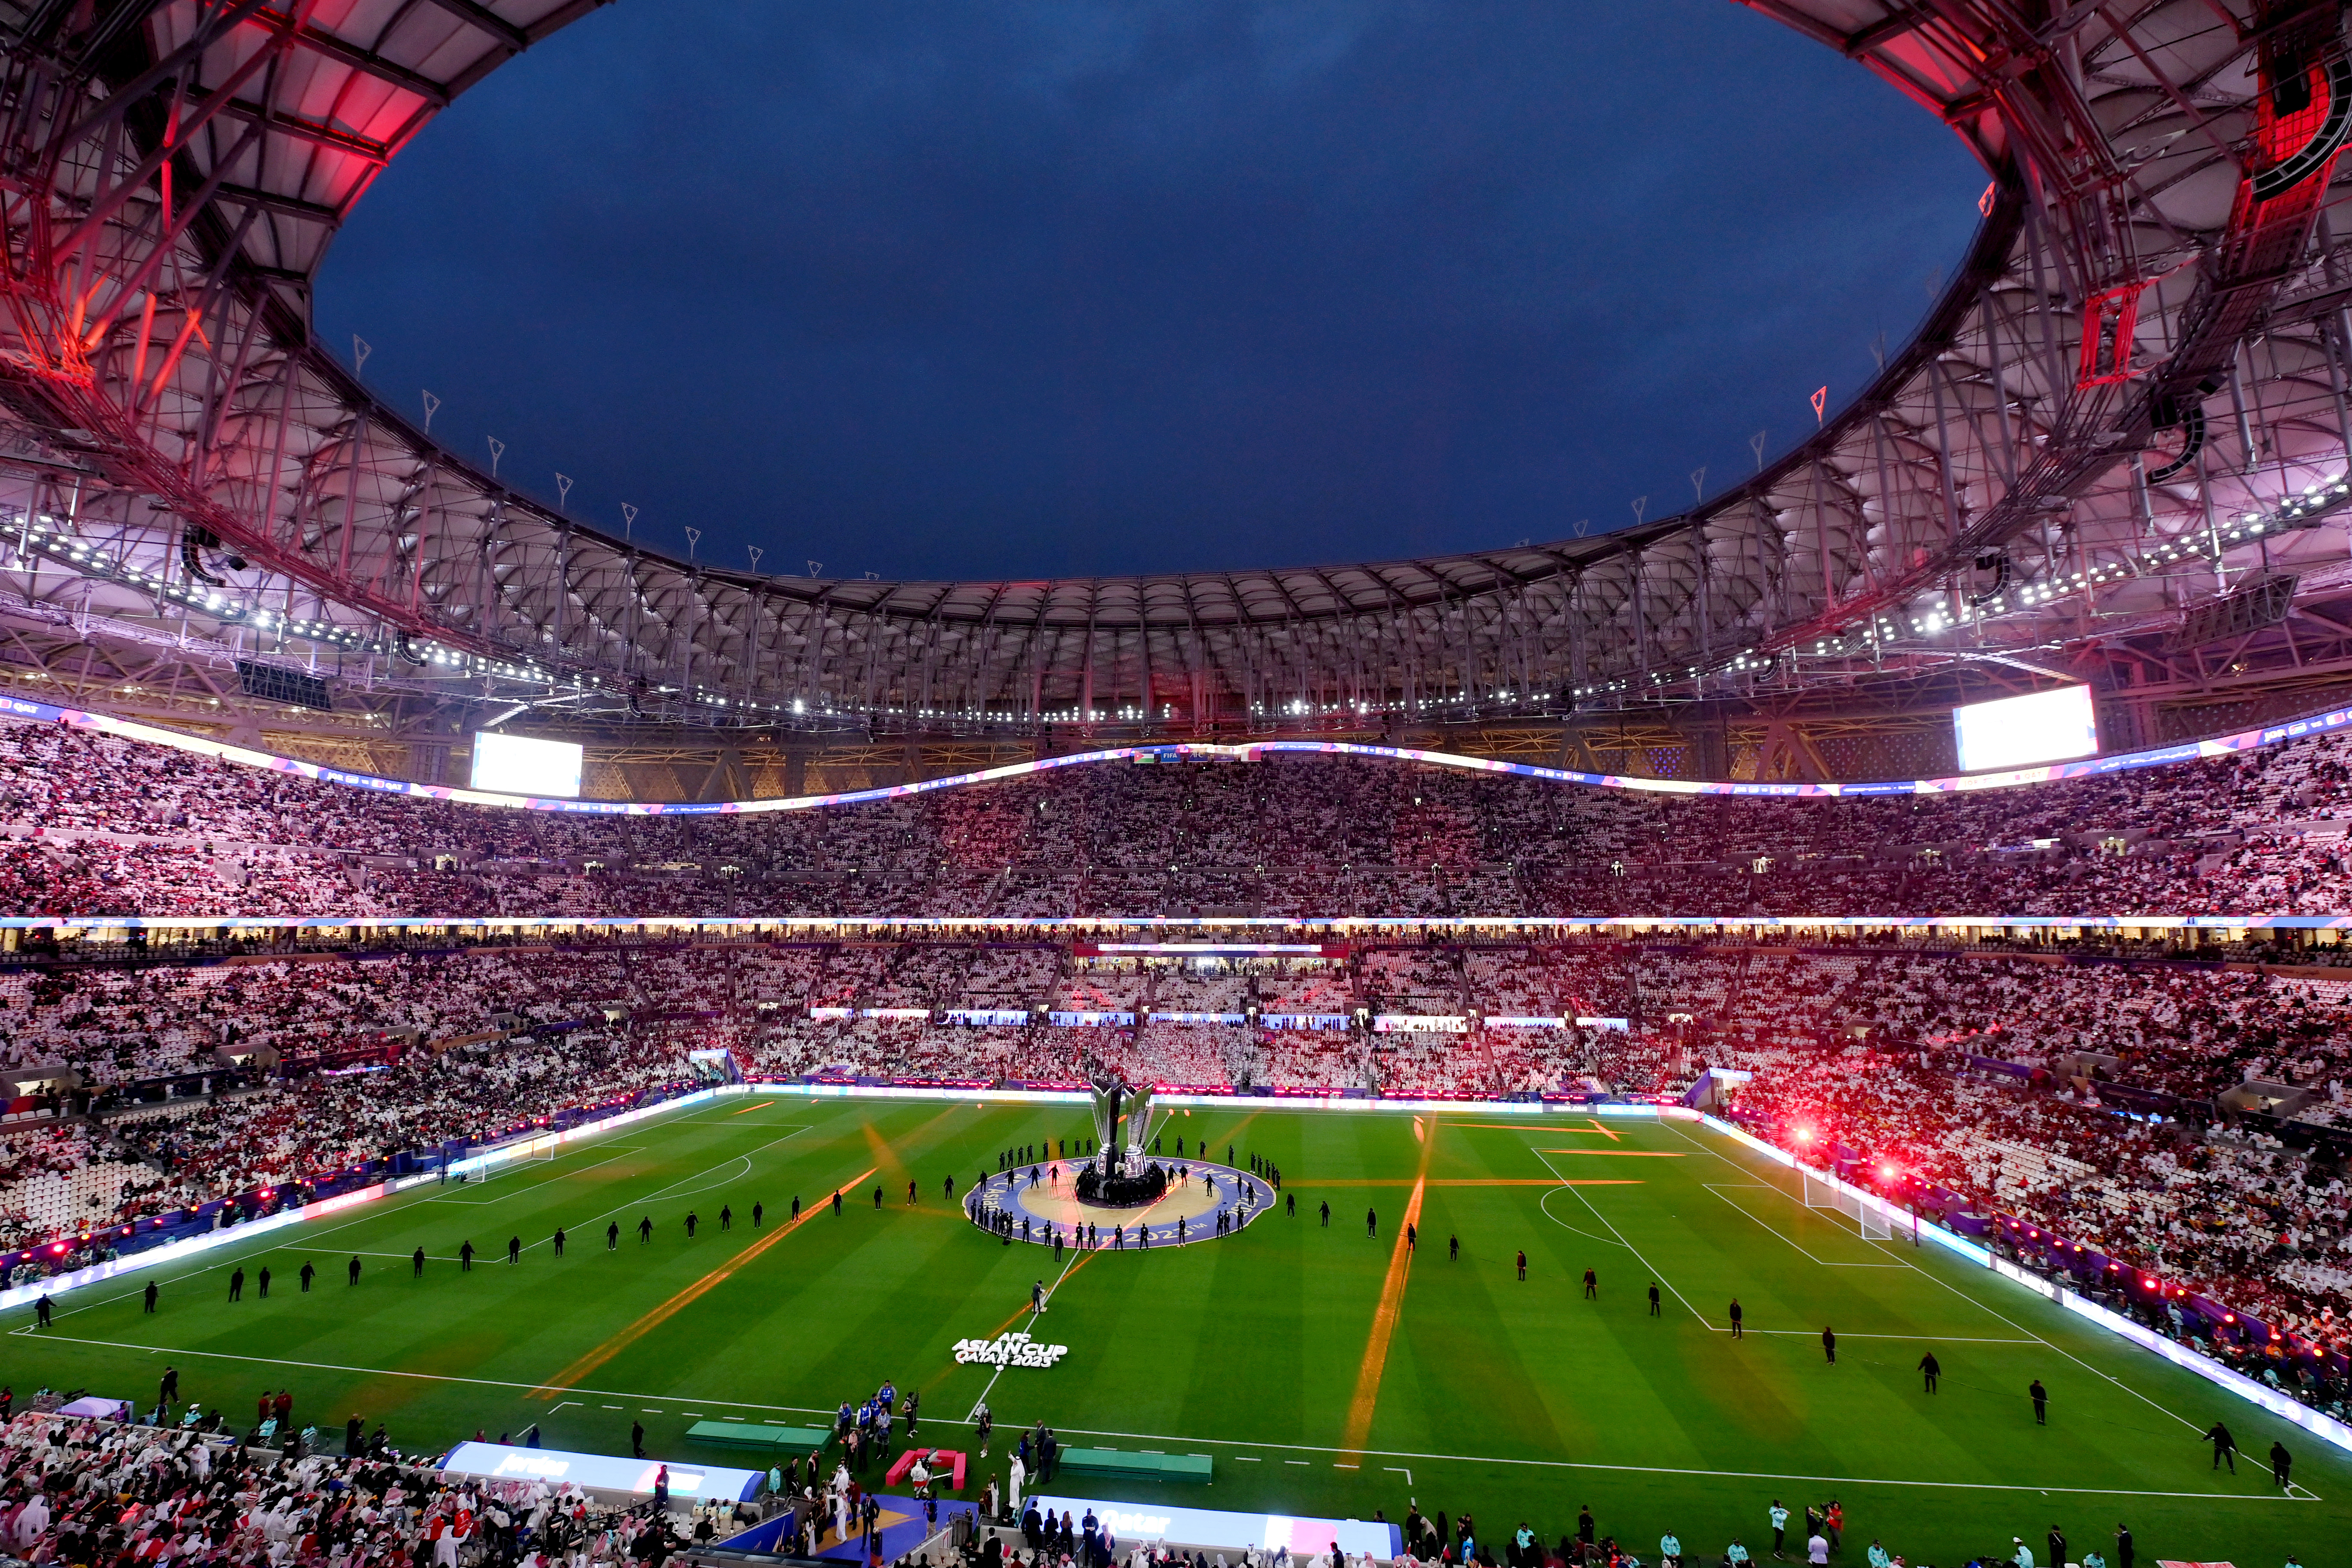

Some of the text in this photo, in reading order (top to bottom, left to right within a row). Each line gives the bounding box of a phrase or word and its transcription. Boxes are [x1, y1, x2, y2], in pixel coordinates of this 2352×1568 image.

[13, 701, 39, 714] QAT
[2264, 729, 2287, 742] JOR
[326, 772, 344, 781] JOR
[385, 782, 403, 790] QAT
[920, 781, 930, 790] JOR
[510, 1140, 540, 1156] Continenal
[320, 1190, 367, 1212] KONAMI
[998, 1332, 1031, 1343] AFC
[951, 1338, 1068, 1357] ASIAN CUP
[954, 1351, 1009, 1364] QATAR
[492, 1453, 570, 1476] Jordan
[1100, 1510, 1171, 1536] Qatar
